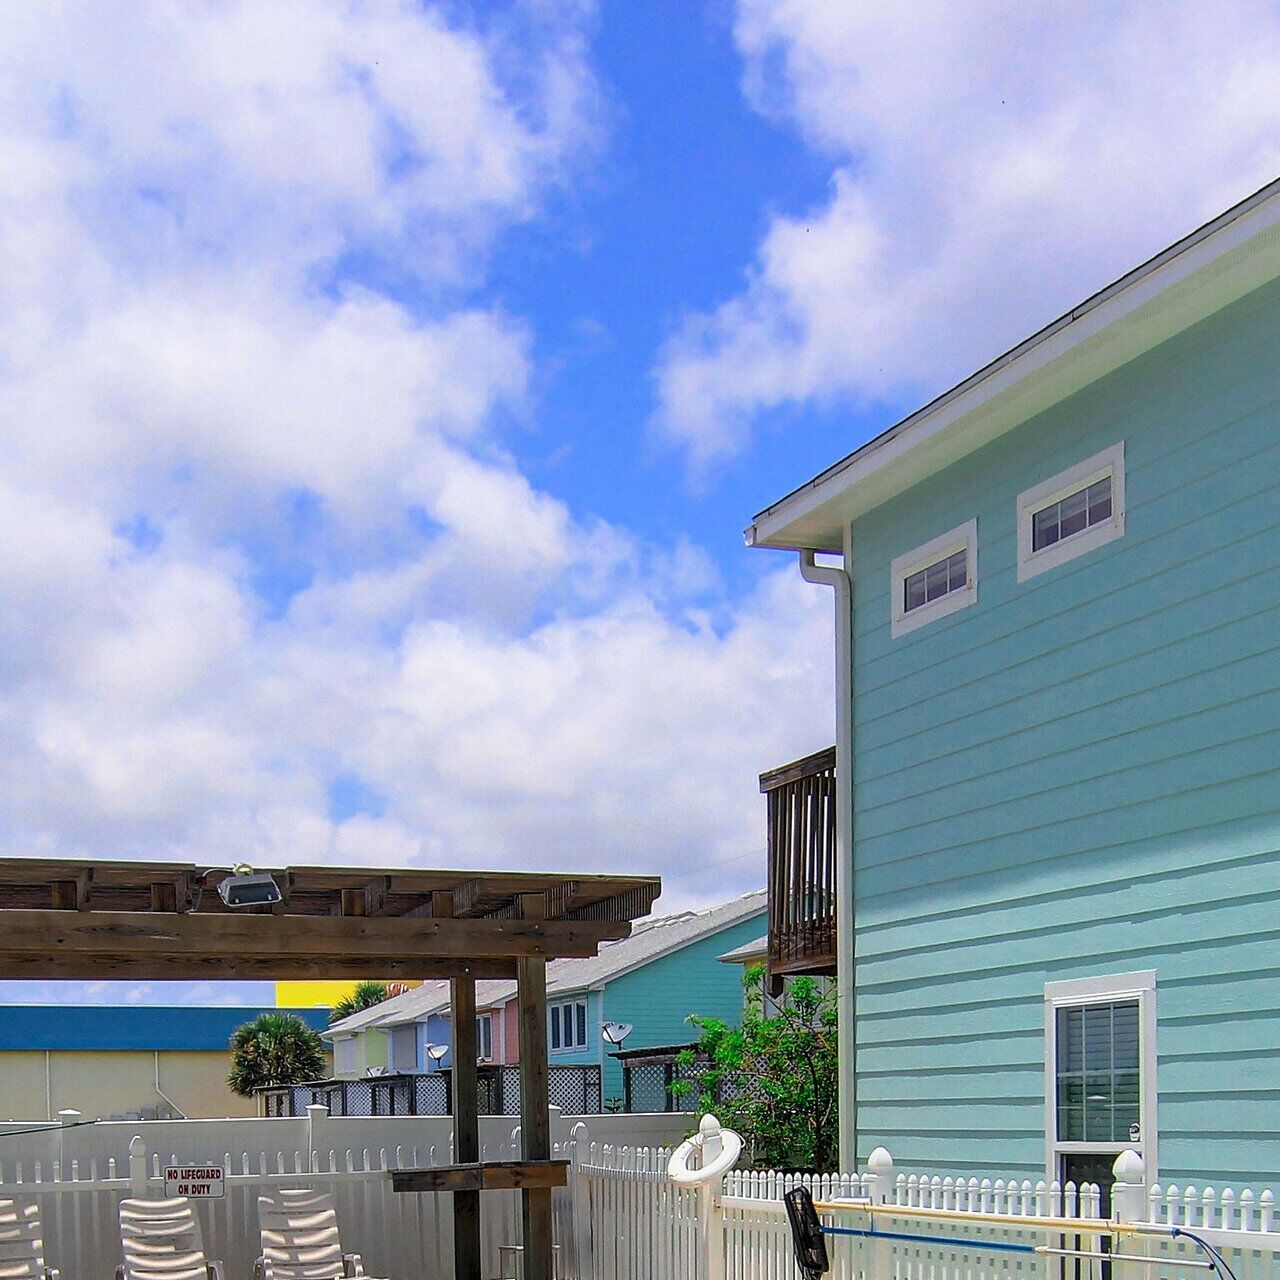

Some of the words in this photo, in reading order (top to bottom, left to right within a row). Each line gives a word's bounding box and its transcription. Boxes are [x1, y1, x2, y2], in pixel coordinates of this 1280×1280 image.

[167, 1169, 178, 1180] NO
[181, 1169, 221, 1180] LIFEGUARD
[178, 1184, 189, 1195] ON
[191, 1184, 211, 1195] DUTY
